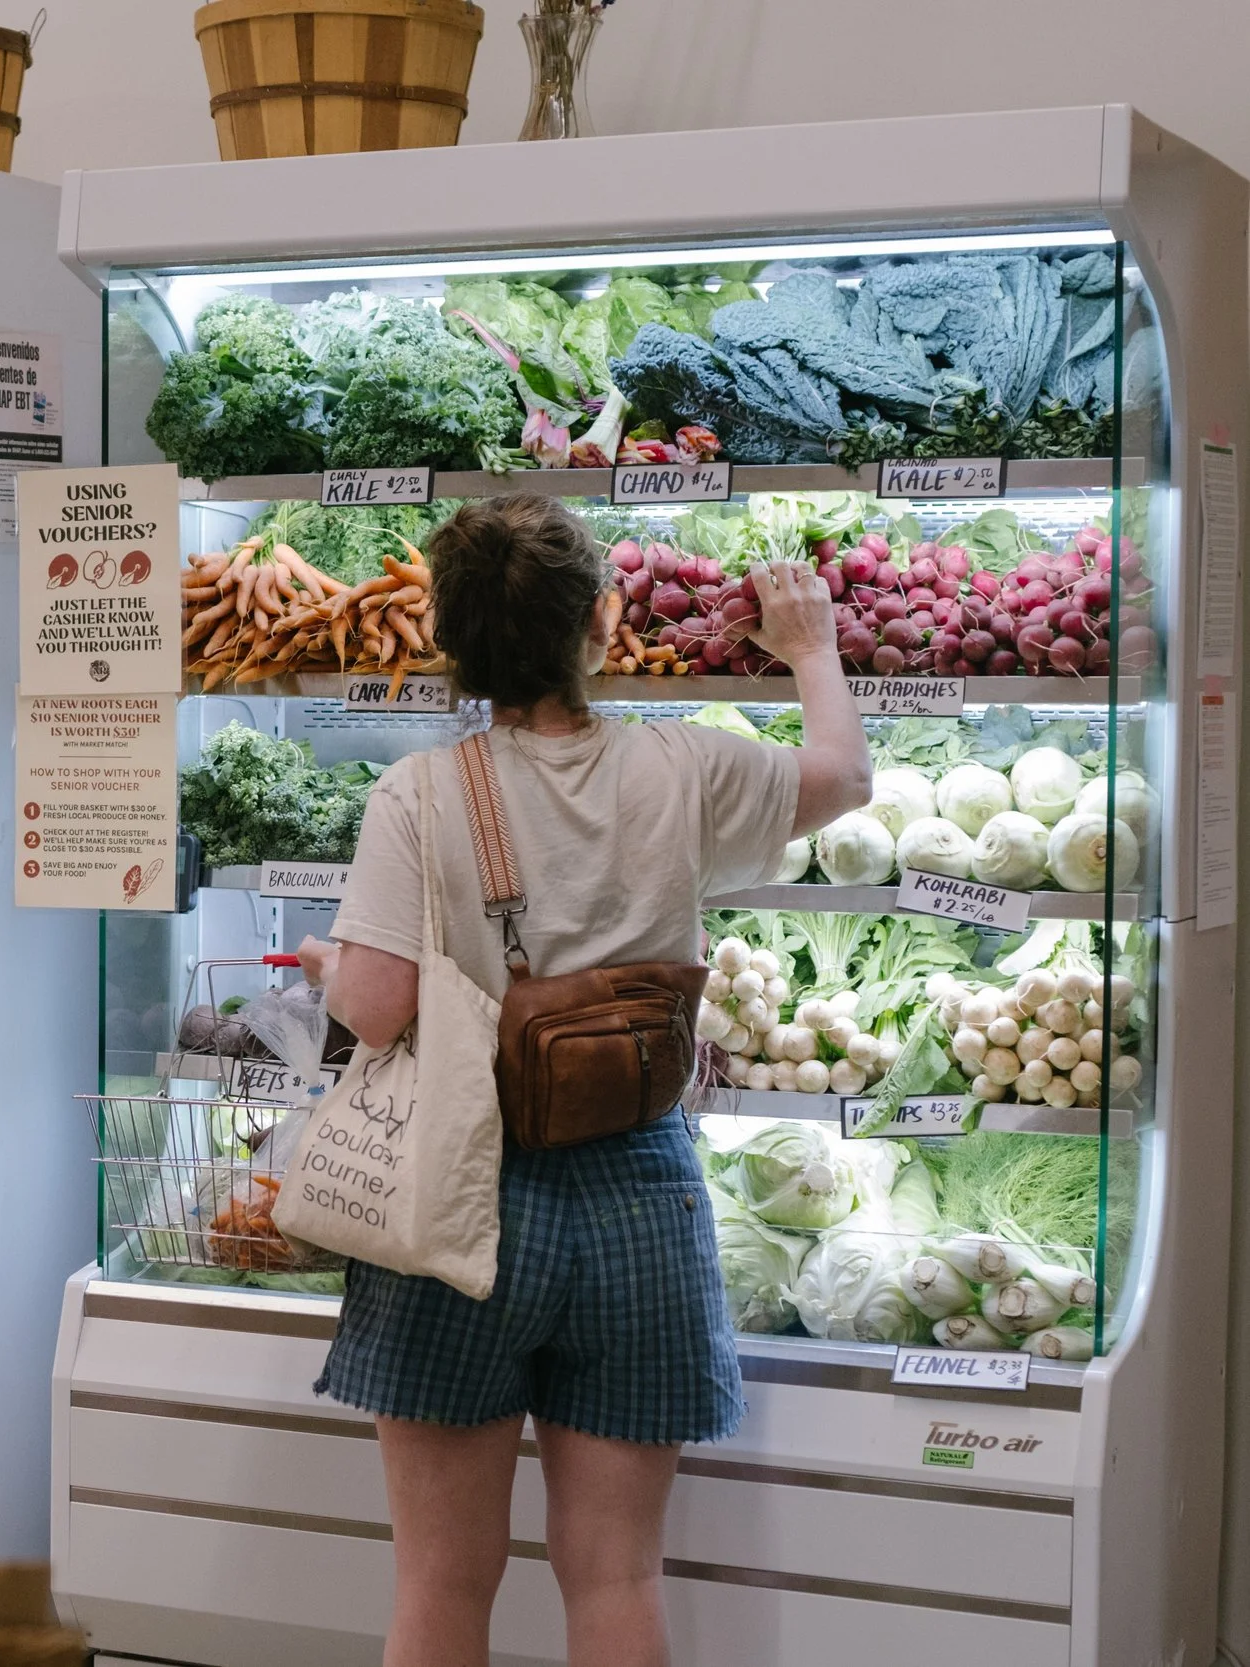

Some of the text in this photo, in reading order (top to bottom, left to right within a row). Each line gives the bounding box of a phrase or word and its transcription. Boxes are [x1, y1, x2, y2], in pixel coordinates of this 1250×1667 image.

[26, 367, 37, 386] de
[15, 391, 30, 410] EBT
[330, 471, 367, 481] CURLY
[621, 471, 685, 494] CHARD
[887, 468, 951, 492] KALE
[67, 483, 127, 501] USING
[327, 480, 382, 502] KALE
[62, 503, 133, 522] SENIOR
[38, 522, 157, 544] VOUCHERS?
[50, 597, 147, 612] JUST LET THE
[43, 611, 155, 626] CASHIER KNOW
[38, 625, 159, 640] AND WE'LL WALK
[36, 638, 162, 654] YOU THROUGH IT!
[348, 682, 414, 702] CARRTS
[32, 699, 158, 709] AT NEW ROOTS EACH
[30, 712, 161, 724] $10 SENIOR VOUCHER
[51, 727, 62, 737] IS
[64, 727, 110, 737] WORTH
[30, 767, 161, 778] HOW TO SHOP WITH YOUR
[51, 781, 140, 791] SENIOR VOUCHER
[92, 812, 127, 820] PRODUCE
[140, 813, 167, 821] HONEY.
[79, 845, 94, 853] $30
[43, 861, 61, 869] SAVE
[94, 862, 118, 870] ENJOY
[43, 869, 87, 878] YOUR FOOD!
[914, 875, 1007, 907] KOHLRABI
[237, 1065, 289, 1094] BEETS
[850, 1105, 922, 1126] TIPS
[302, 1183, 387, 1230] school
[901, 1354, 982, 1377] FENNEL
[925, 1421, 1044, 1453] Turbo air
[930, 1451, 962, 1460] NATURAL
